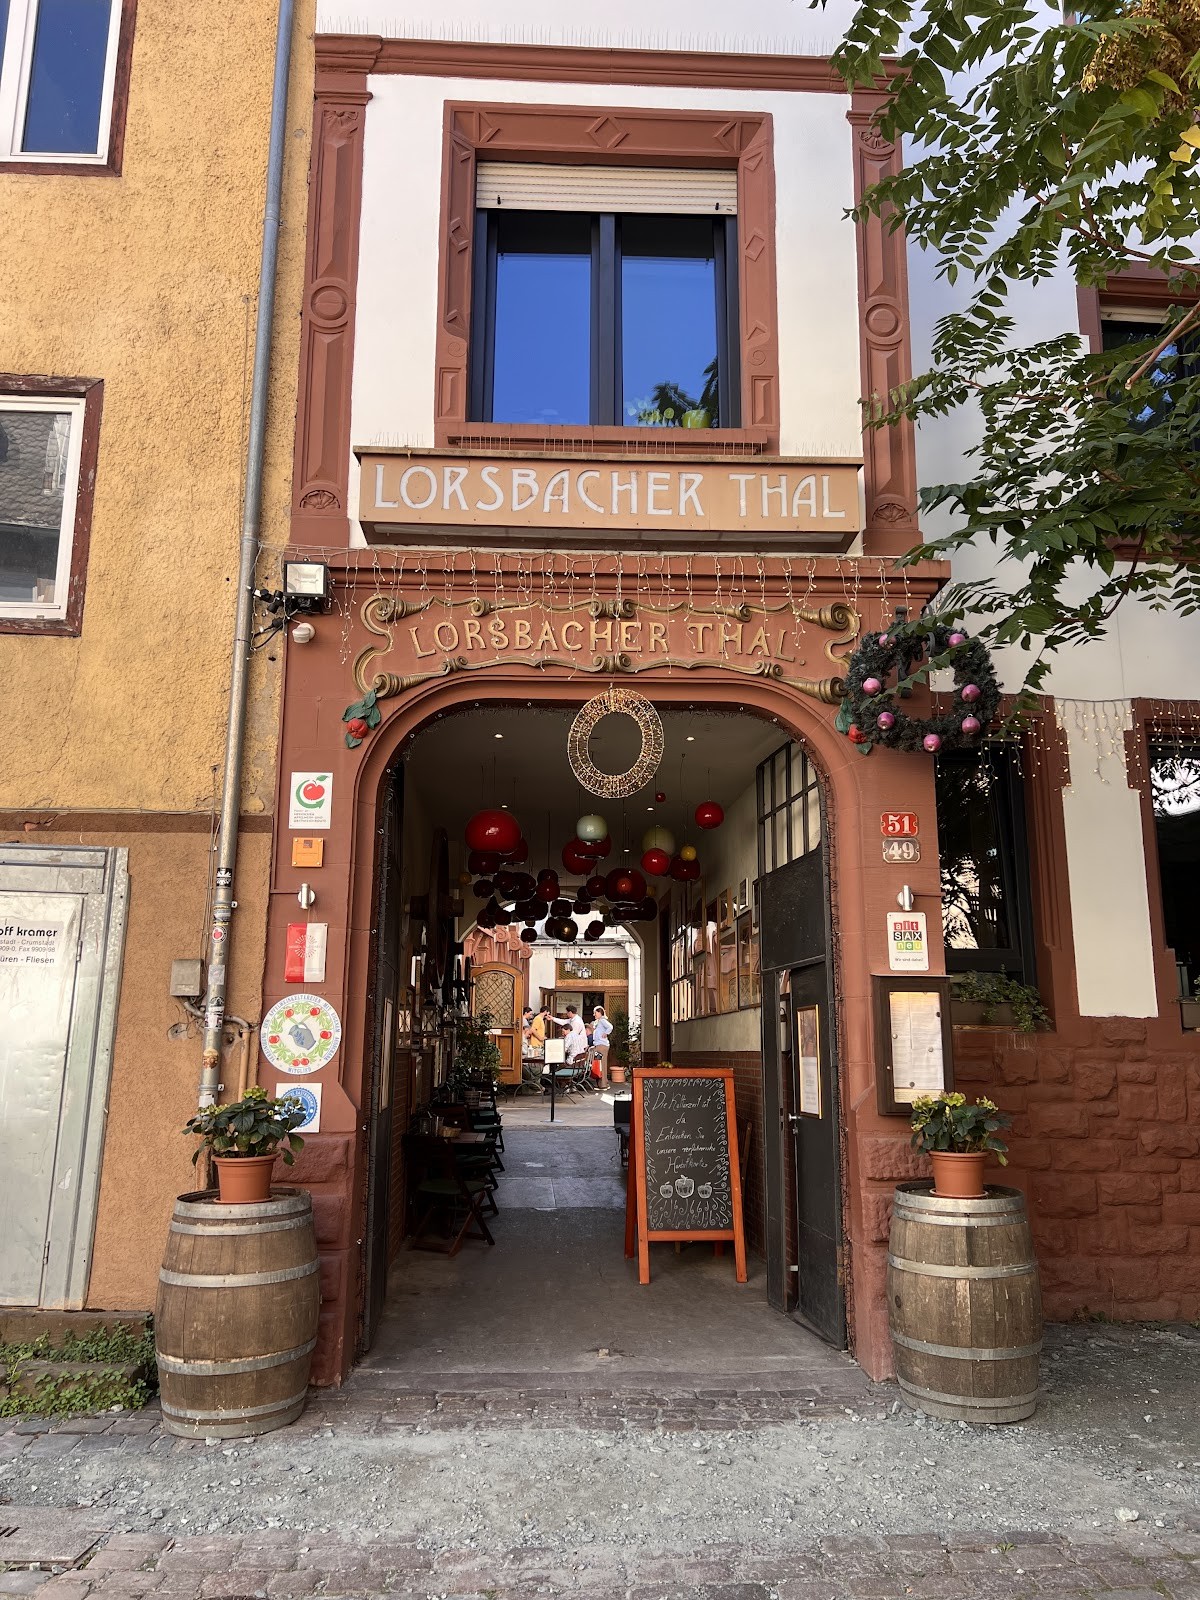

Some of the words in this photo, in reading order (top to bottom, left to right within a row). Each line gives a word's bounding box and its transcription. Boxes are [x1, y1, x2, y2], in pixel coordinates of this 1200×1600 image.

[374, 464, 704, 517] LORSBACHER
[729, 473, 846, 519] THAL
[408, 619, 669, 659] LORSBACHER
[887, 814, 912, 834] 51
[888, 841, 915, 860] 49
[16, 926, 58, 936] kramer
[894, 921, 918, 930] alt
[894, 931, 922, 941] SAX
[897, 941, 922, 950] neu
[652, 1091, 668, 1111] Die
[675, 1112, 686, 1124] da
